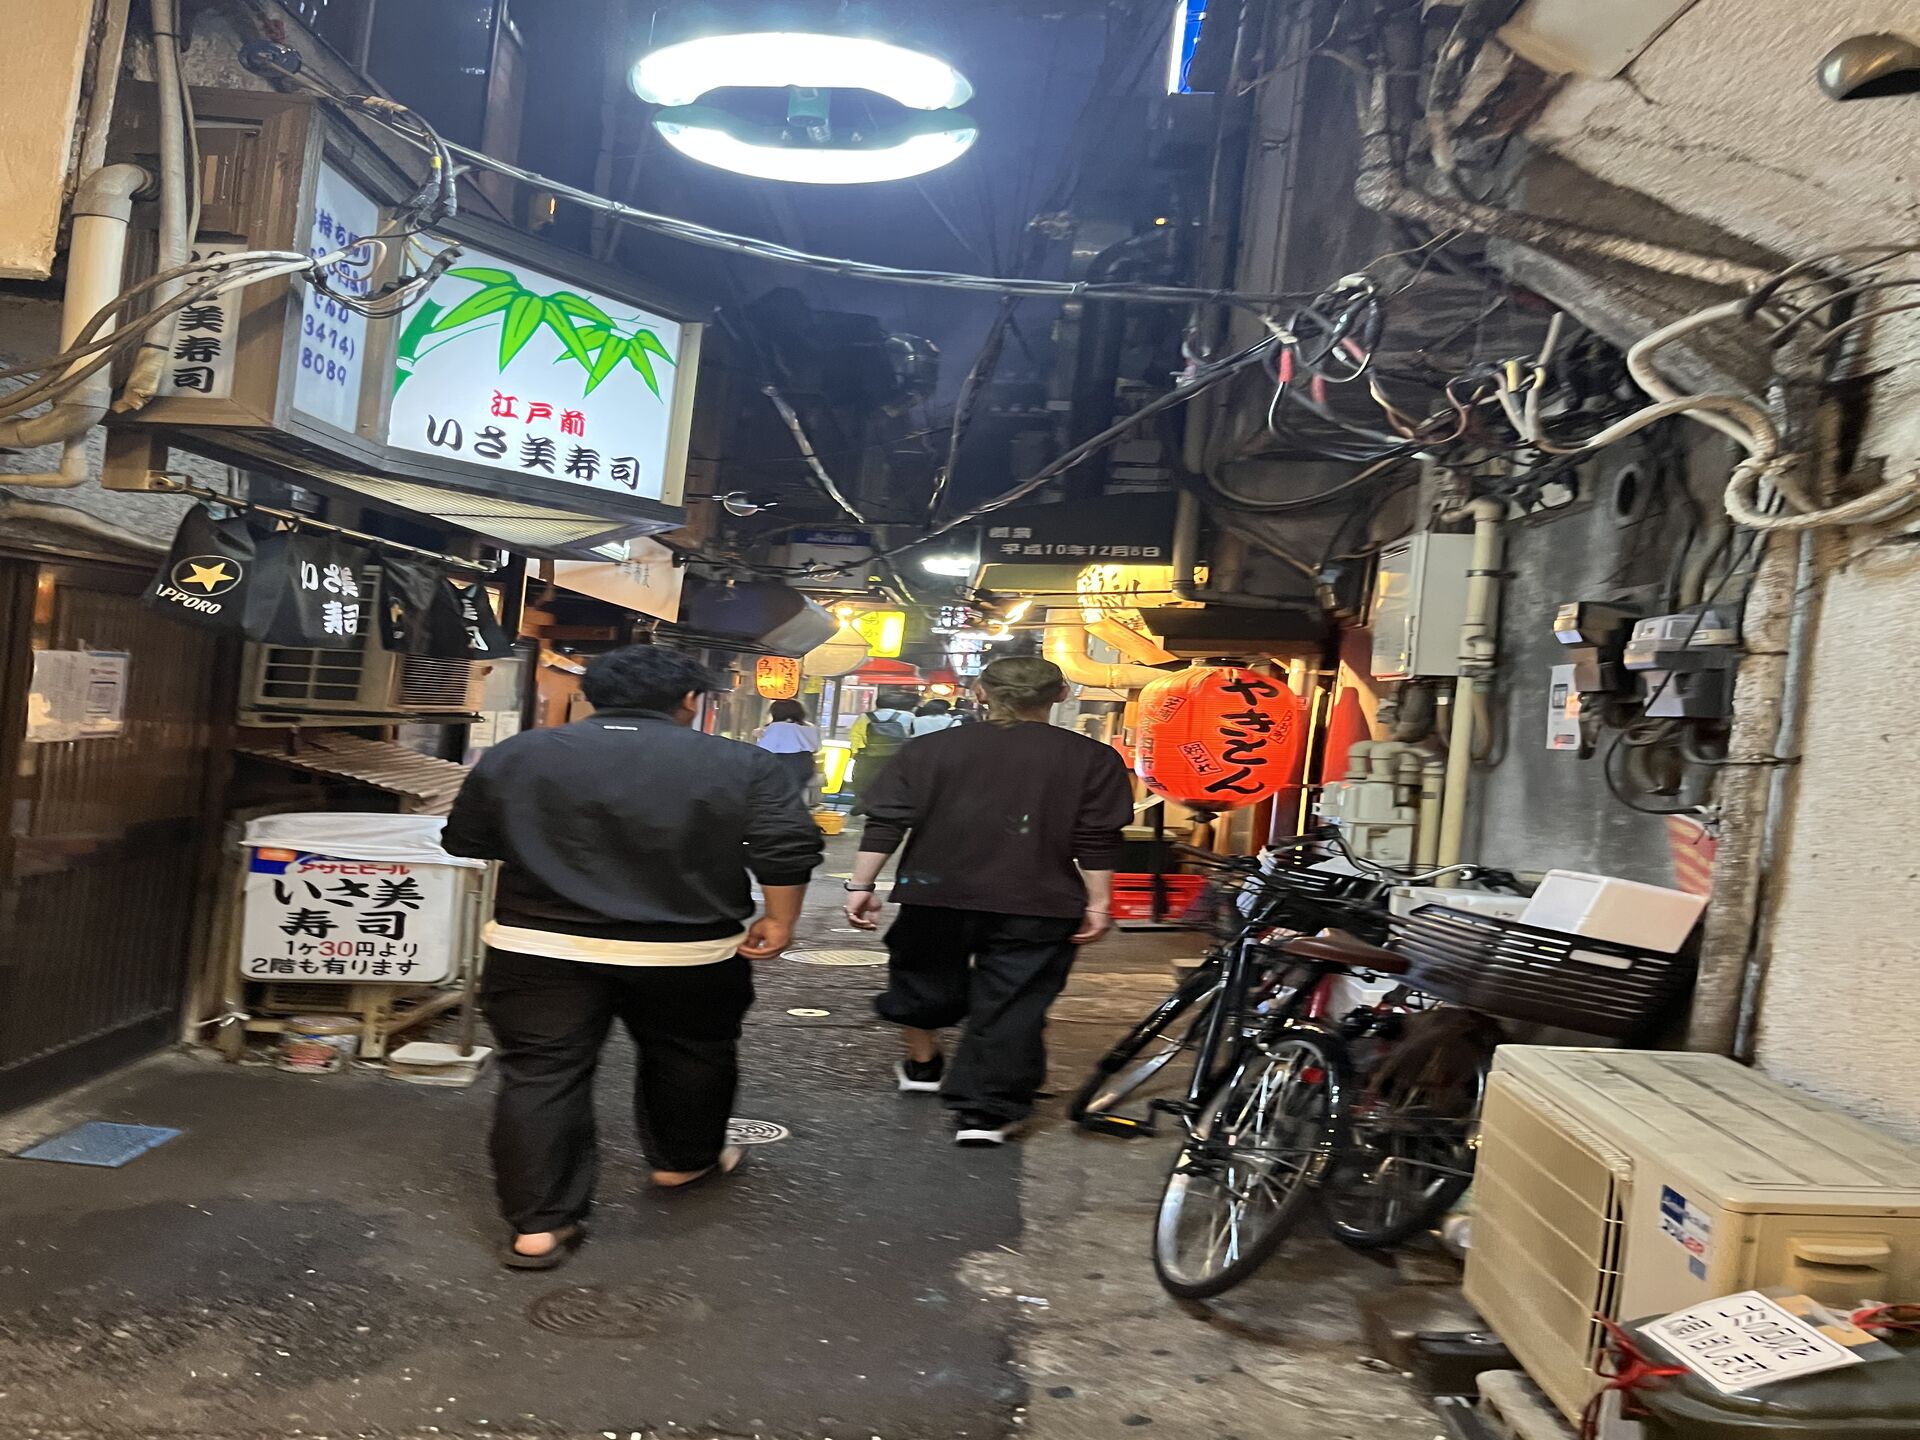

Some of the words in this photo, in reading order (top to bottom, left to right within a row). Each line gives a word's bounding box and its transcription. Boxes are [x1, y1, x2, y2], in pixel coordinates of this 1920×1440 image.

[302, 347, 347, 386] 8089
[490, 389, 587, 438] 江戸前
[426, 415, 640, 490] いさ美寿司
[1204, 678, 1280, 795] やきとん
[273, 876, 425, 910] いさ美
[279, 907, 407, 941] 寿司
[251, 957, 420, 976] 2階も有ります
